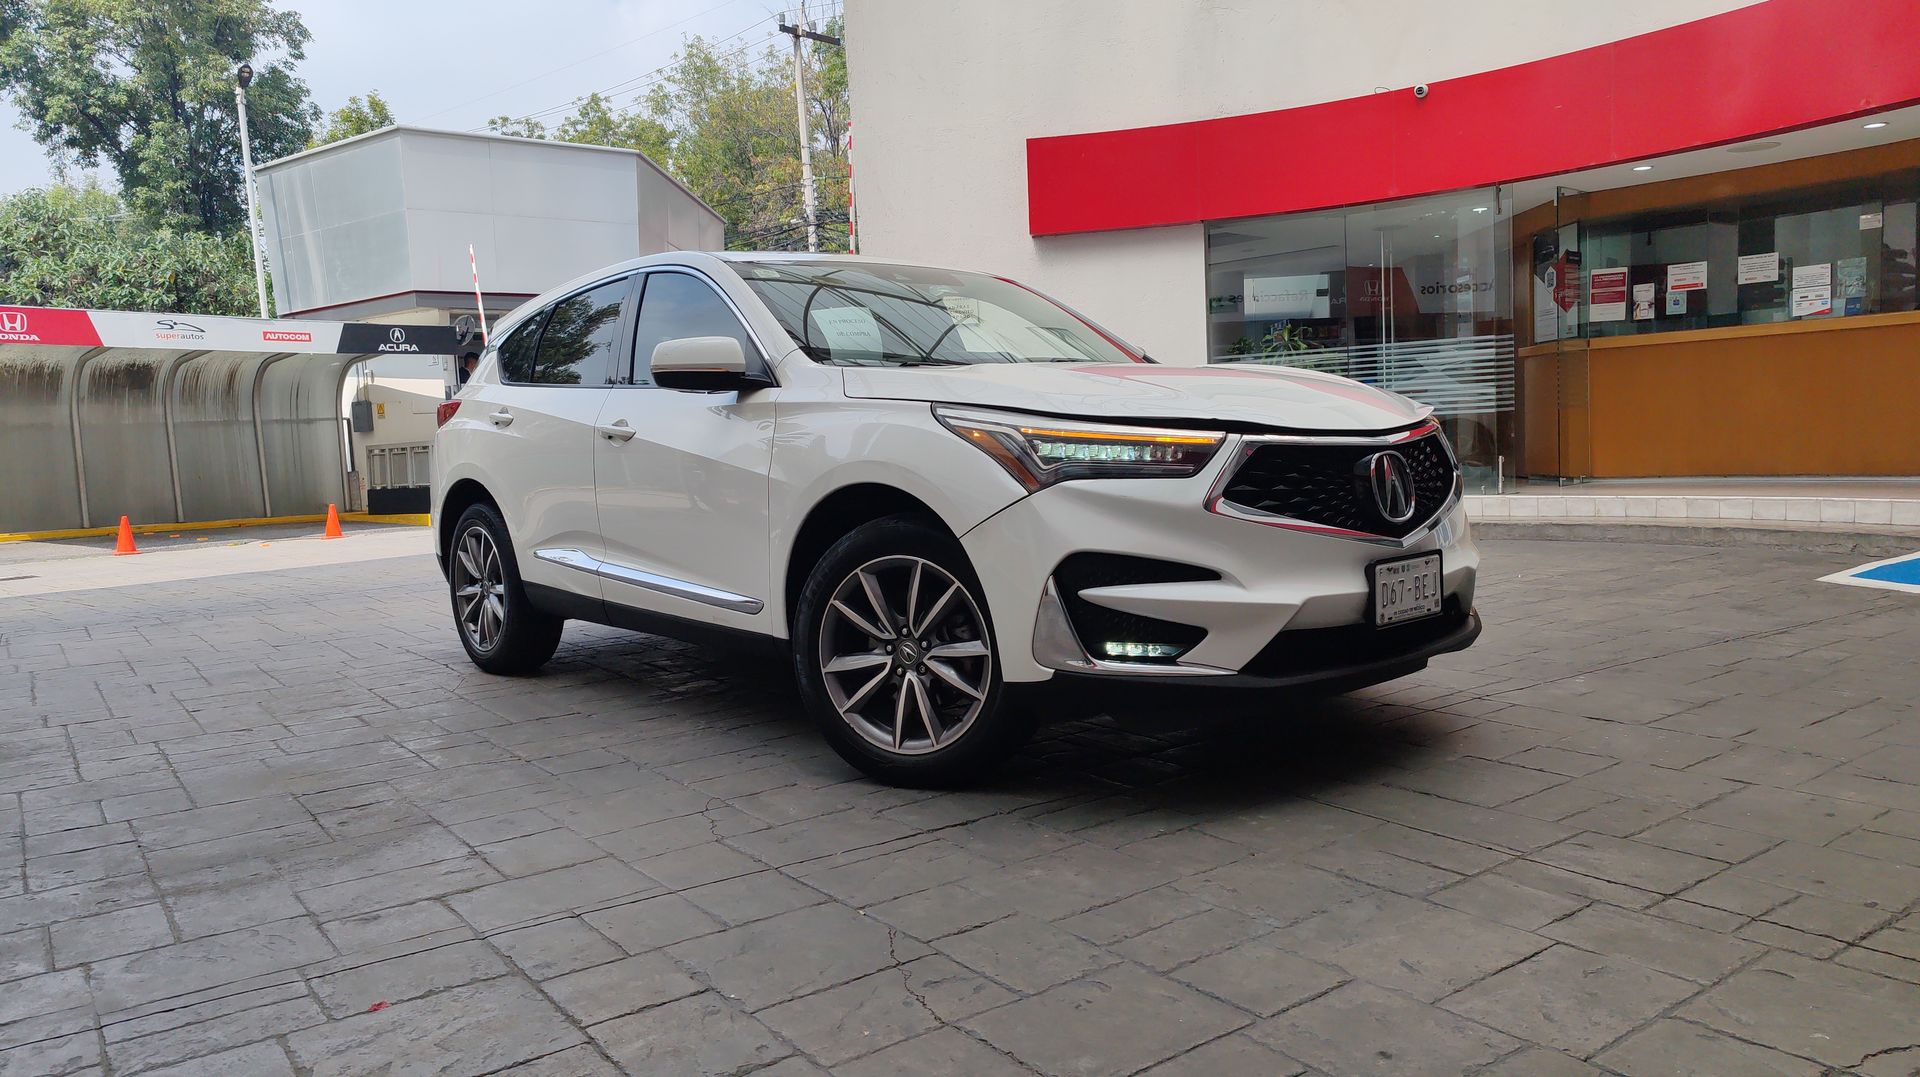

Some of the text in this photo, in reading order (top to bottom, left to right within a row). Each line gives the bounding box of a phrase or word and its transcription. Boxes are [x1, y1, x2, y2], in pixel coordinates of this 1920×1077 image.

[155, 332, 205, 341] superautos
[265, 332, 310, 341] AUTOCOM
[378, 343, 420, 352] ACURA
[1380, 570, 1437, 609] D67-BEJ
